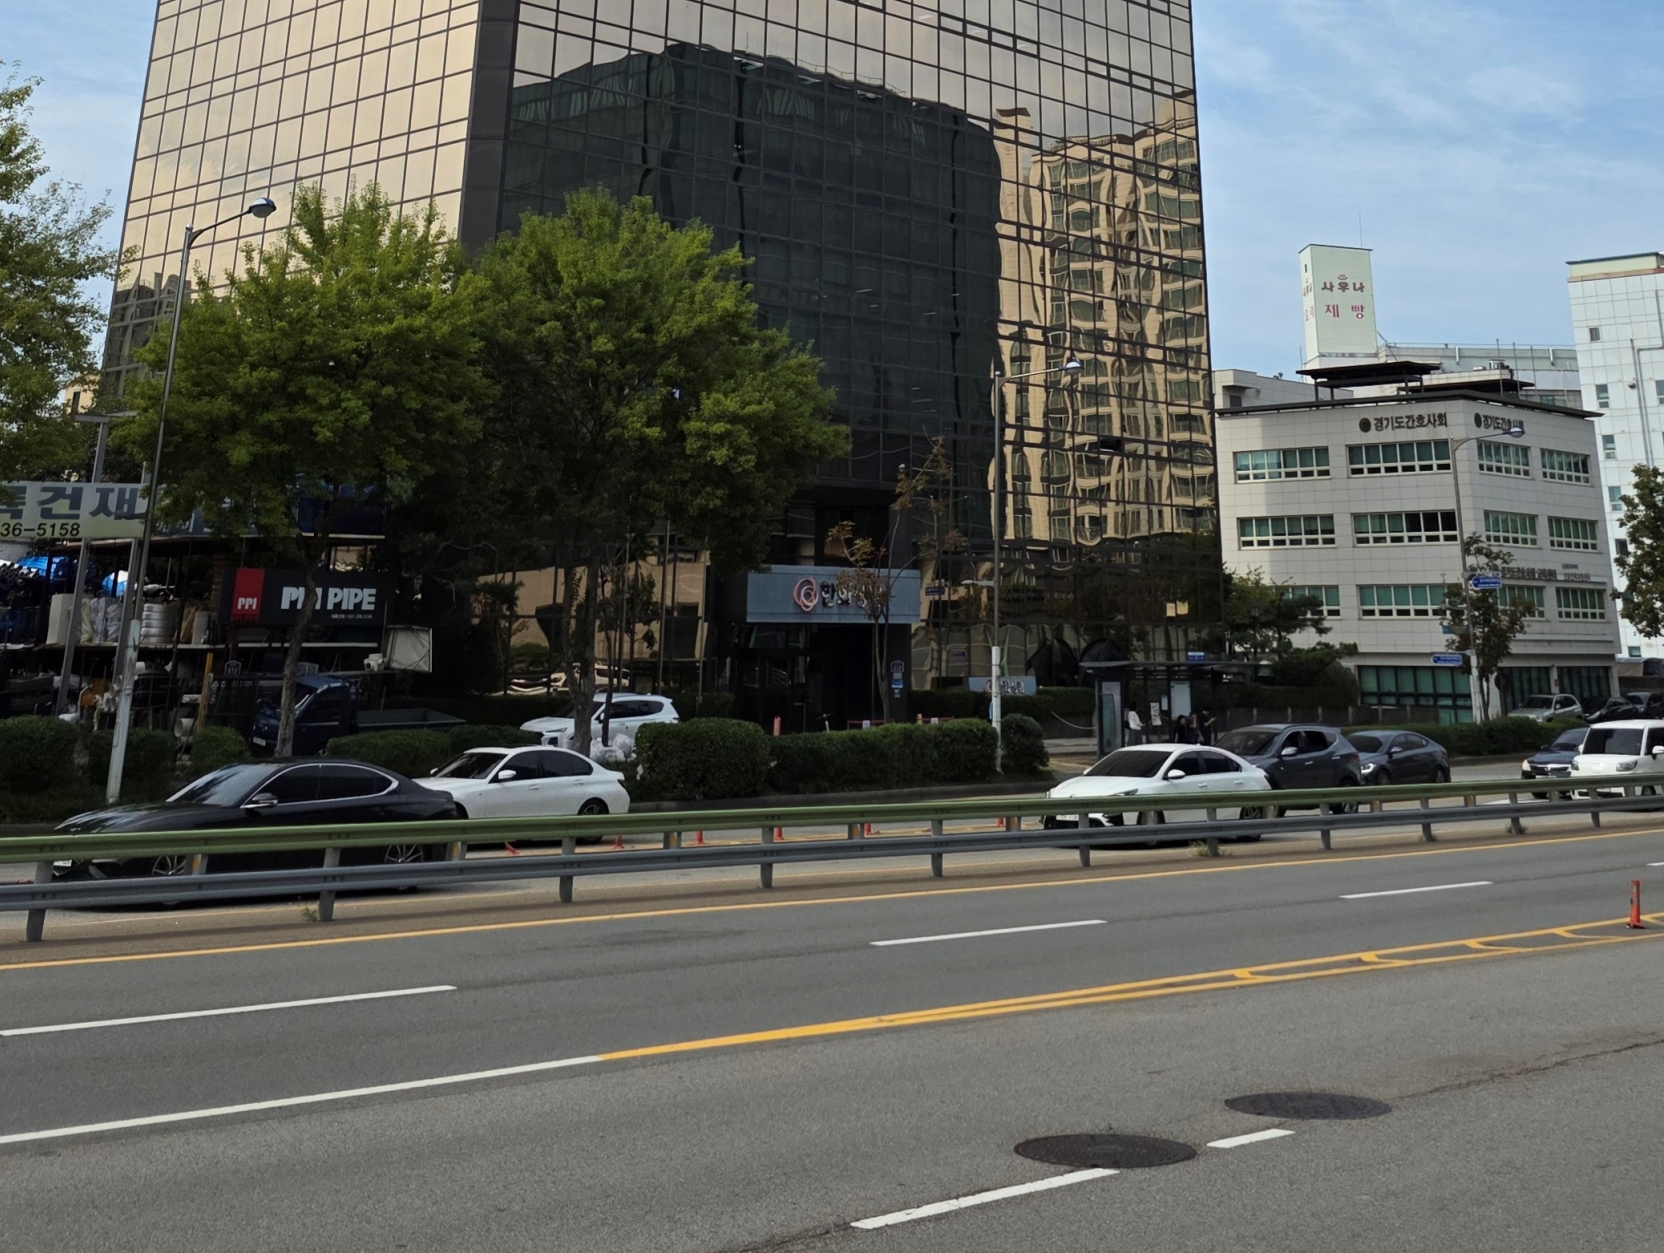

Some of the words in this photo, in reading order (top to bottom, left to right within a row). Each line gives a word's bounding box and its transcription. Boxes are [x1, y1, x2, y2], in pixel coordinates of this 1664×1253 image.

[1321, 281, 1365, 293] 사우나
[1373, 413, 1448, 431] 경기도간호사회
[237, 597, 257, 610] PPI
[326, 587, 377, 610] PIPE
